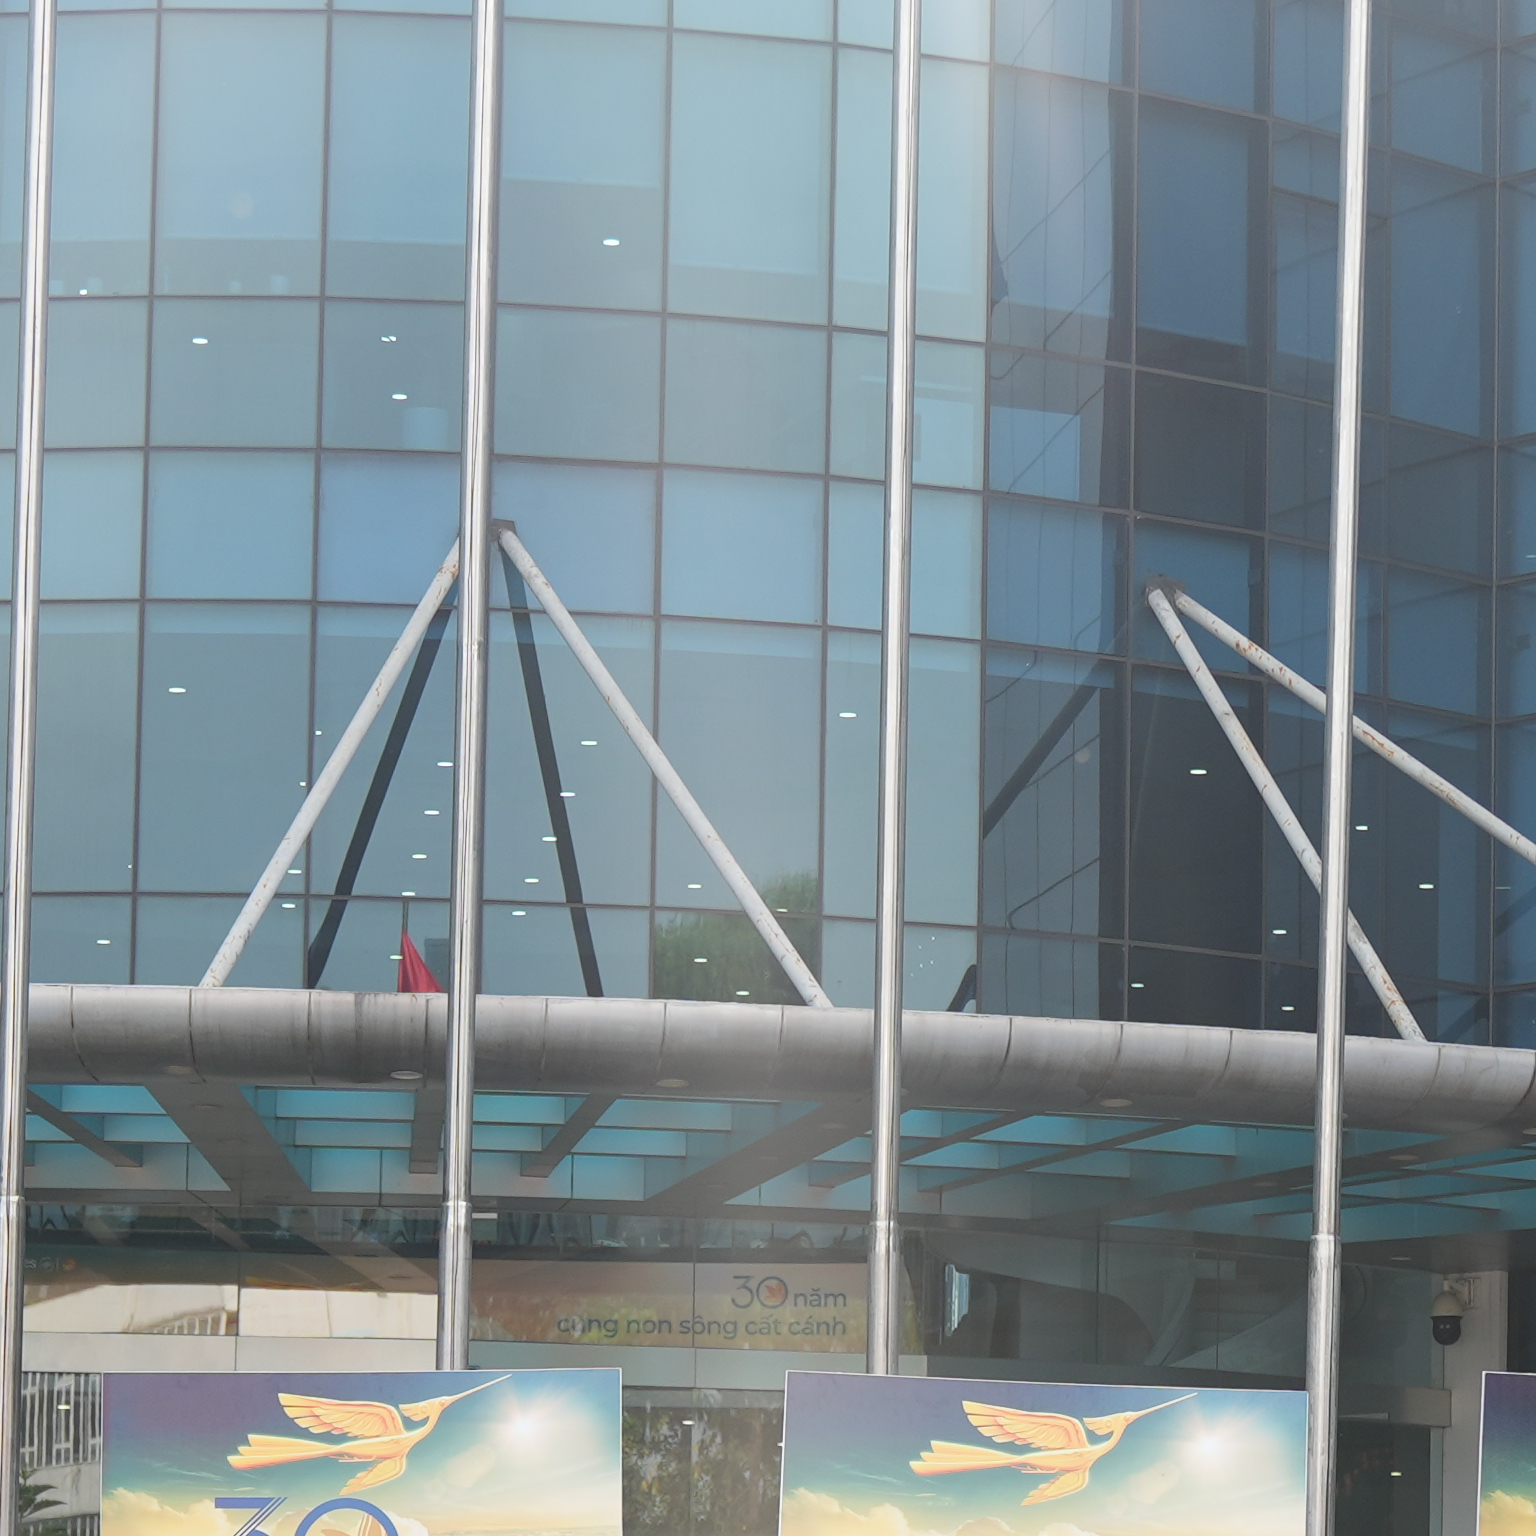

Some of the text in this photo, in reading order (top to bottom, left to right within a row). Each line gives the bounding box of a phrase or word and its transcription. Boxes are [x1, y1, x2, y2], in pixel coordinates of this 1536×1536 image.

[731, 1275, 847, 1309] 30 năm
[626, 1317, 672, 1335] non
[679, 1315, 738, 1340] sông
[745, 1314, 782, 1335] cất
[788, 1315, 847, 1336] cánh
